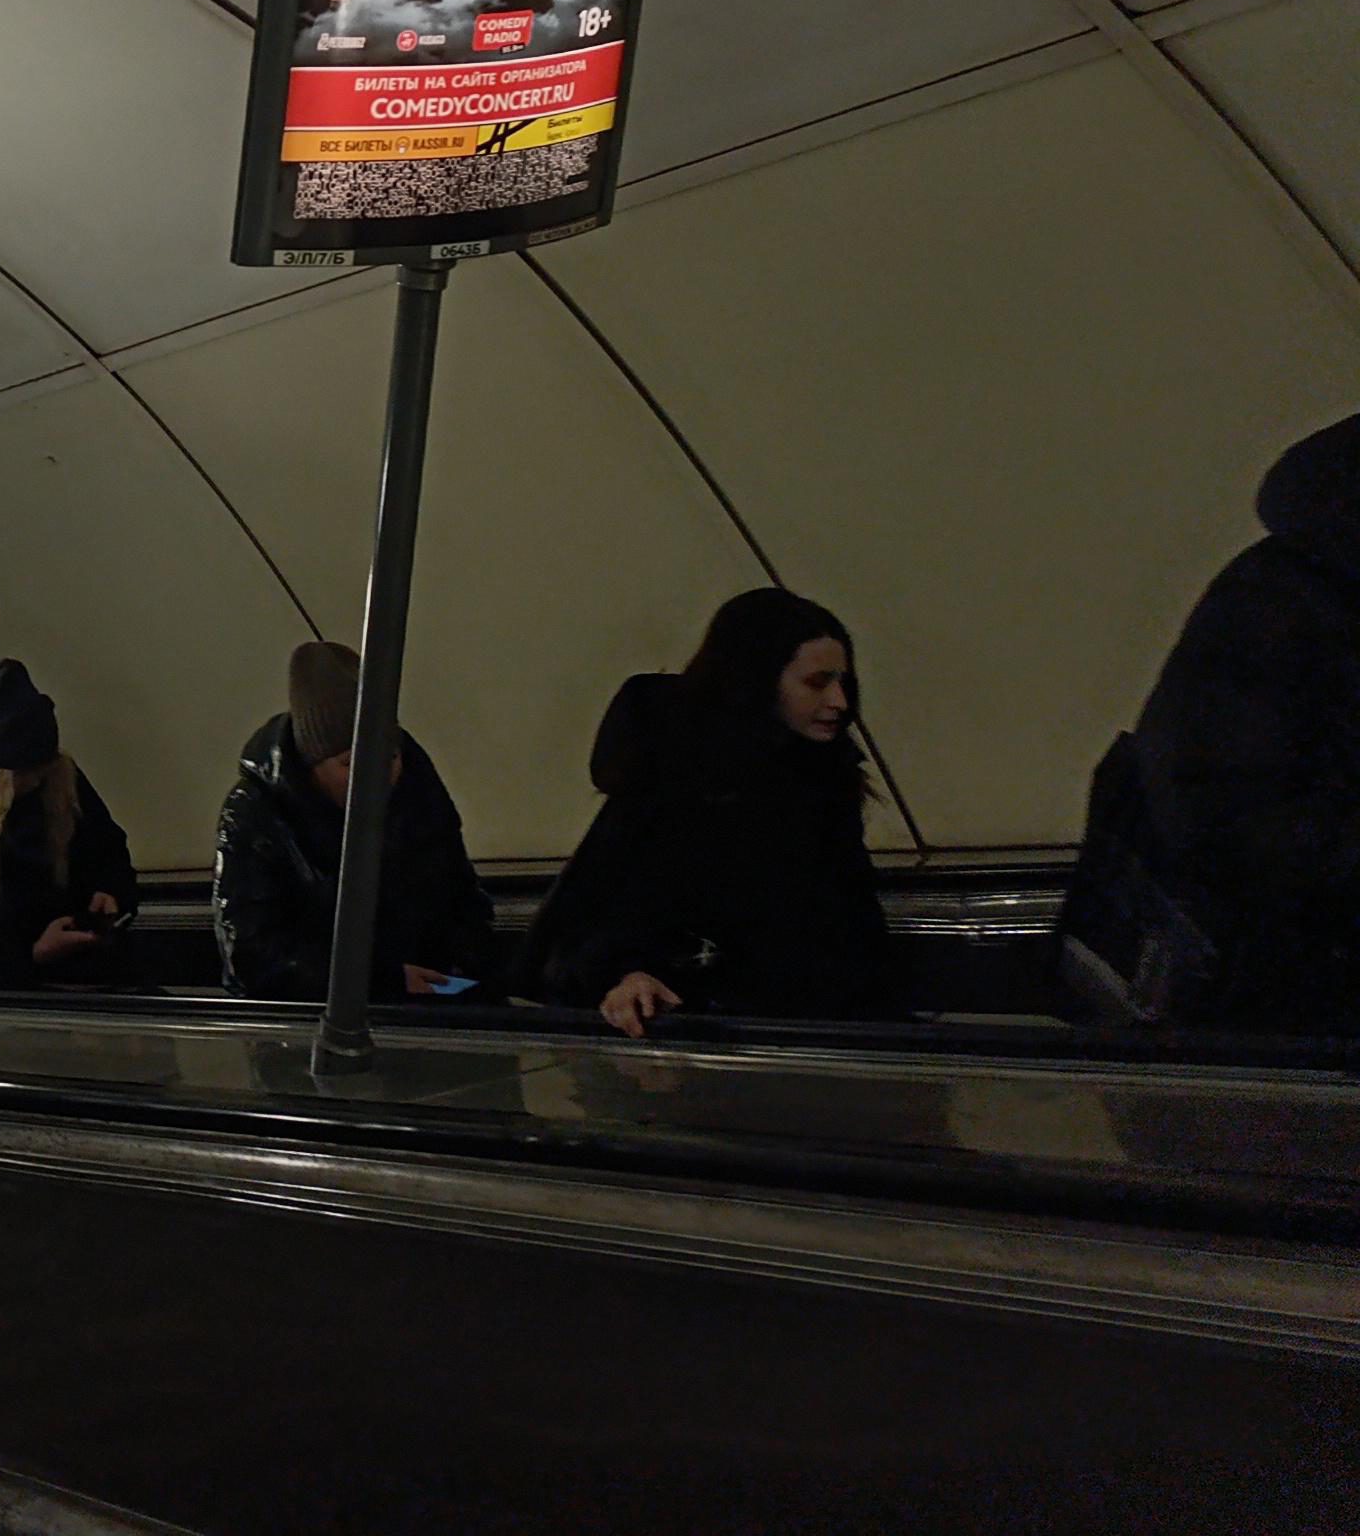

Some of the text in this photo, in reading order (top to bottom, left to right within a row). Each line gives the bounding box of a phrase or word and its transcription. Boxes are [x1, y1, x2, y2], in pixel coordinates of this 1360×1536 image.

[478, 16, 529, 31] COMEDY
[578, 6, 612, 37] 18+
[483, 31, 521, 44] RADIO
[354, 59, 587, 91] БИЛЕТЫ НА САЙТЕ ОРГАНИЗАТОРА
[370, 82, 575, 119] COMEDYCONCERT.RU
[320, 141, 341, 152] ВСЕ
[344, 140, 392, 152] БИЛЕТЫ
[441, 243, 481, 257] 0643Б
